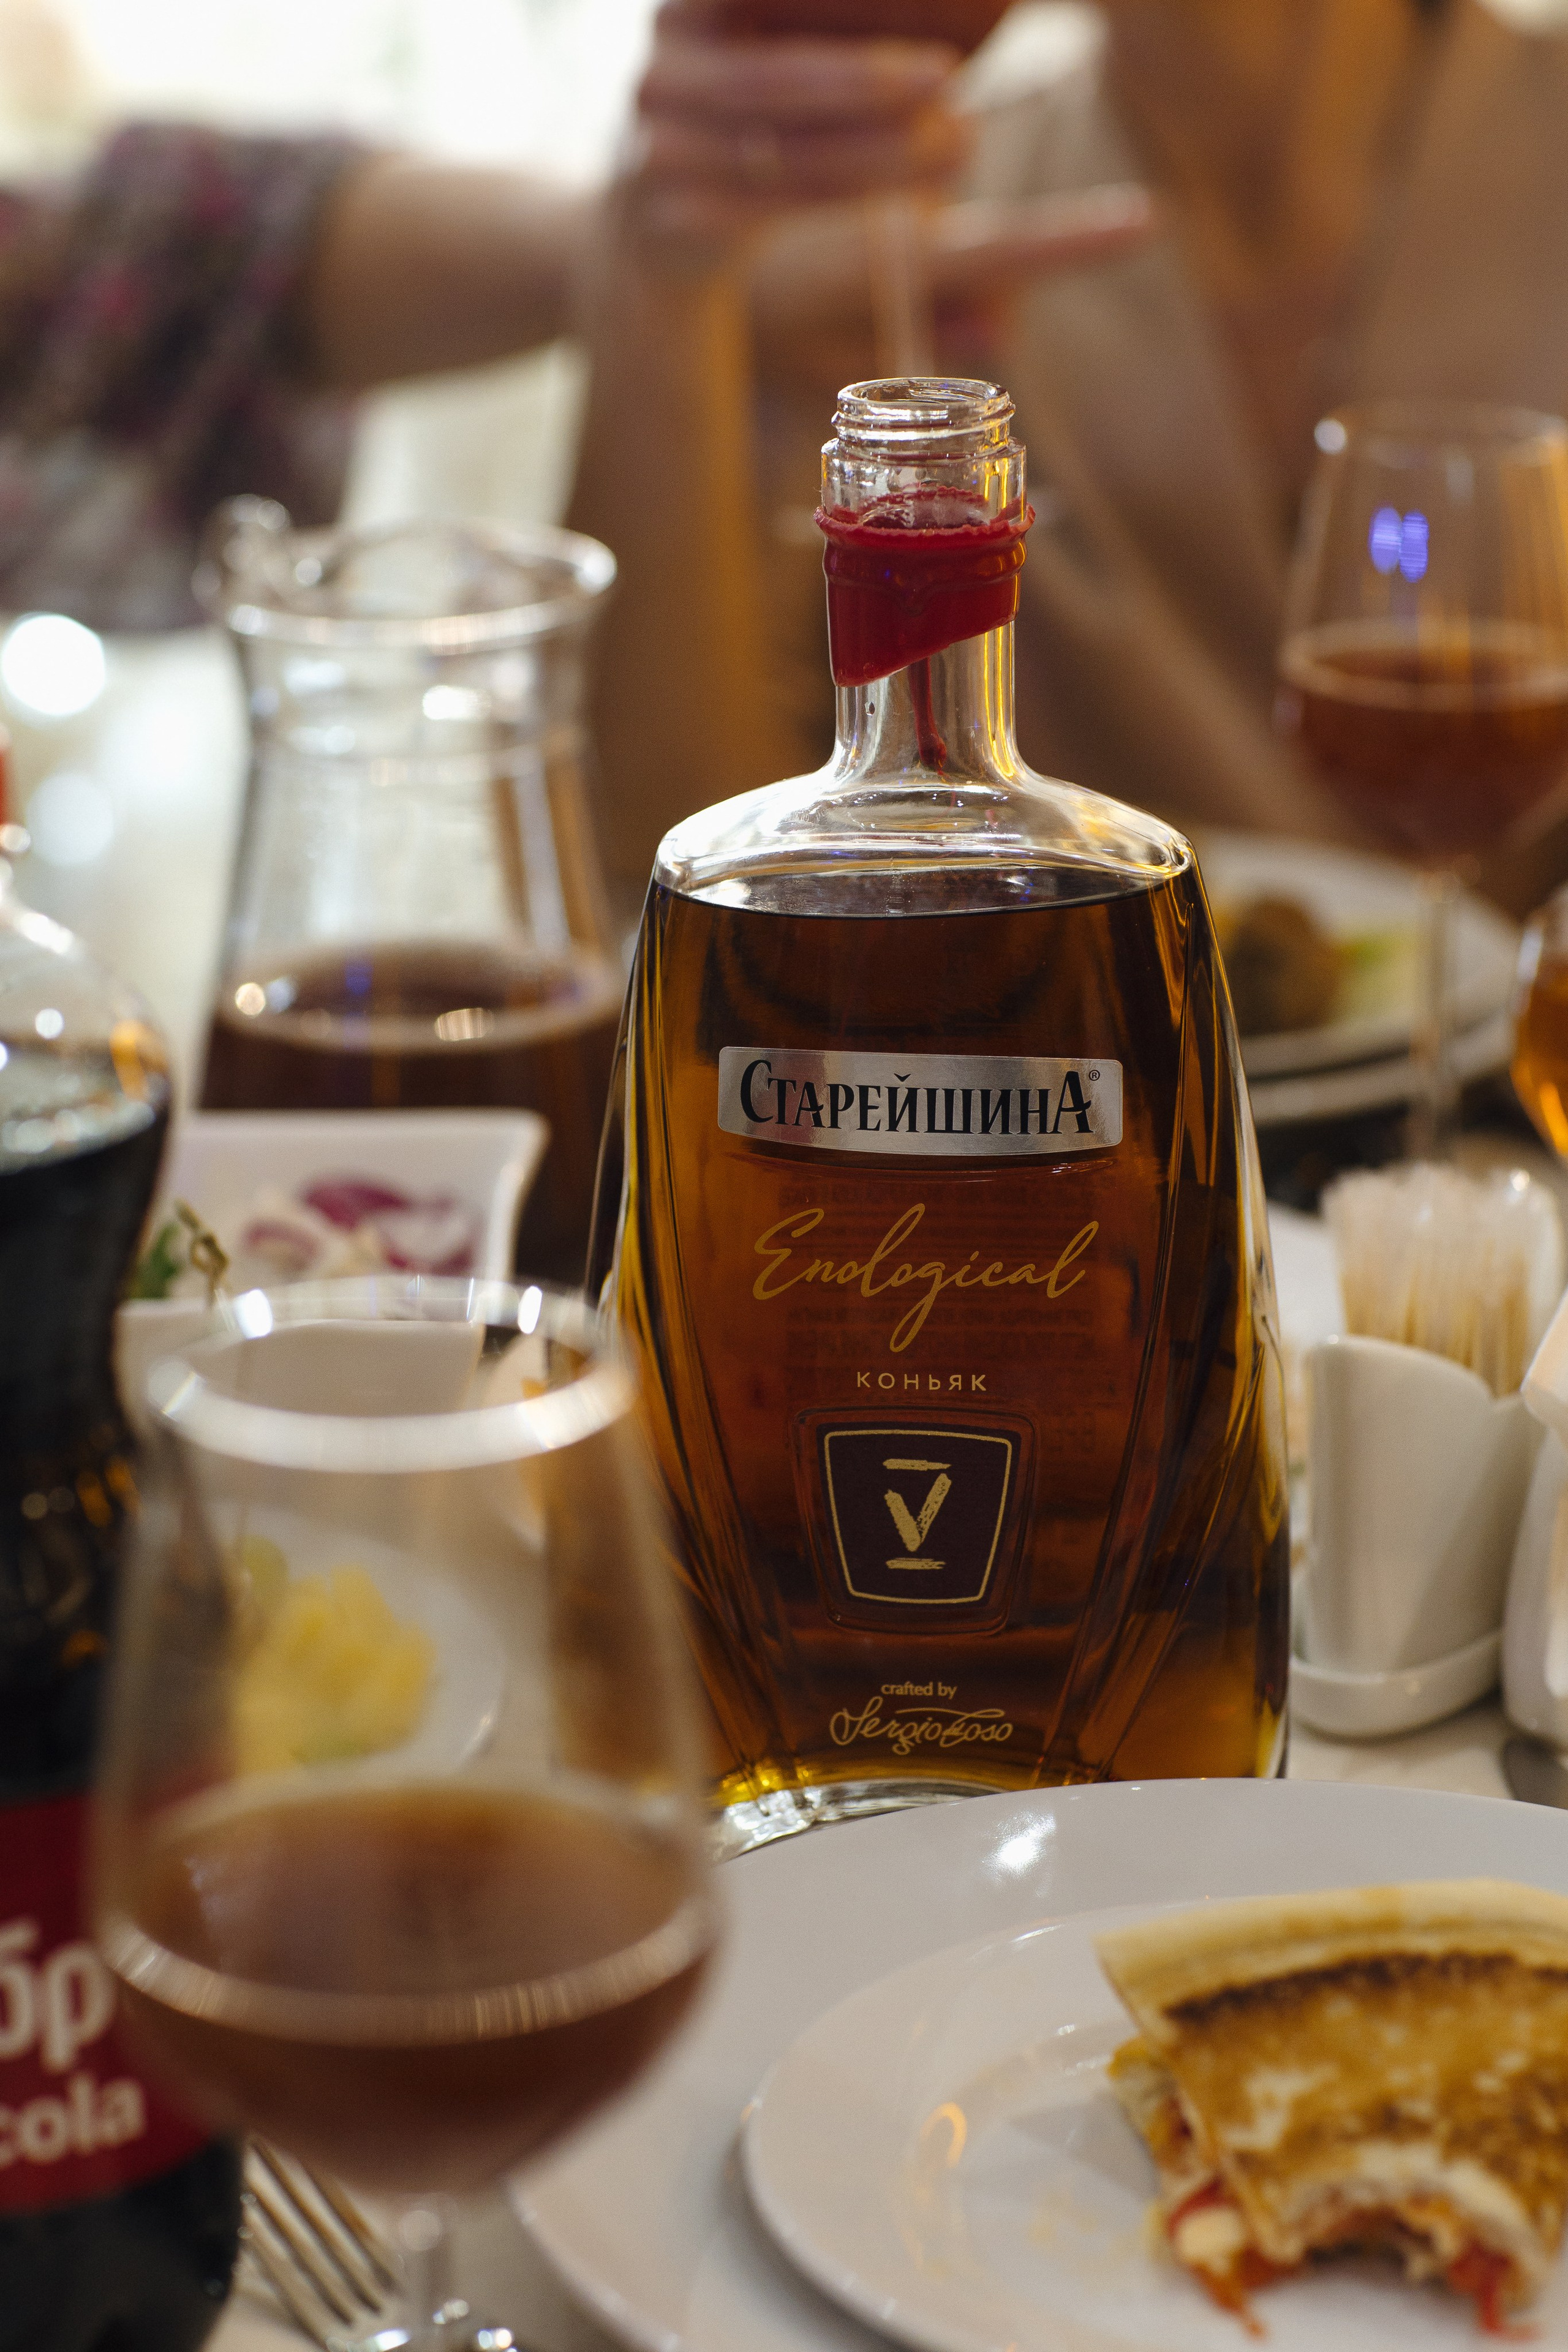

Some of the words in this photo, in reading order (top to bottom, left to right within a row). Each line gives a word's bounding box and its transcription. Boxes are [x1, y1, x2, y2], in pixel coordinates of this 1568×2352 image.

[752, 1203, 1099, 1352] Enological
[880, 1681, 933, 1696] crafted
[937, 1681, 957, 1700] by
